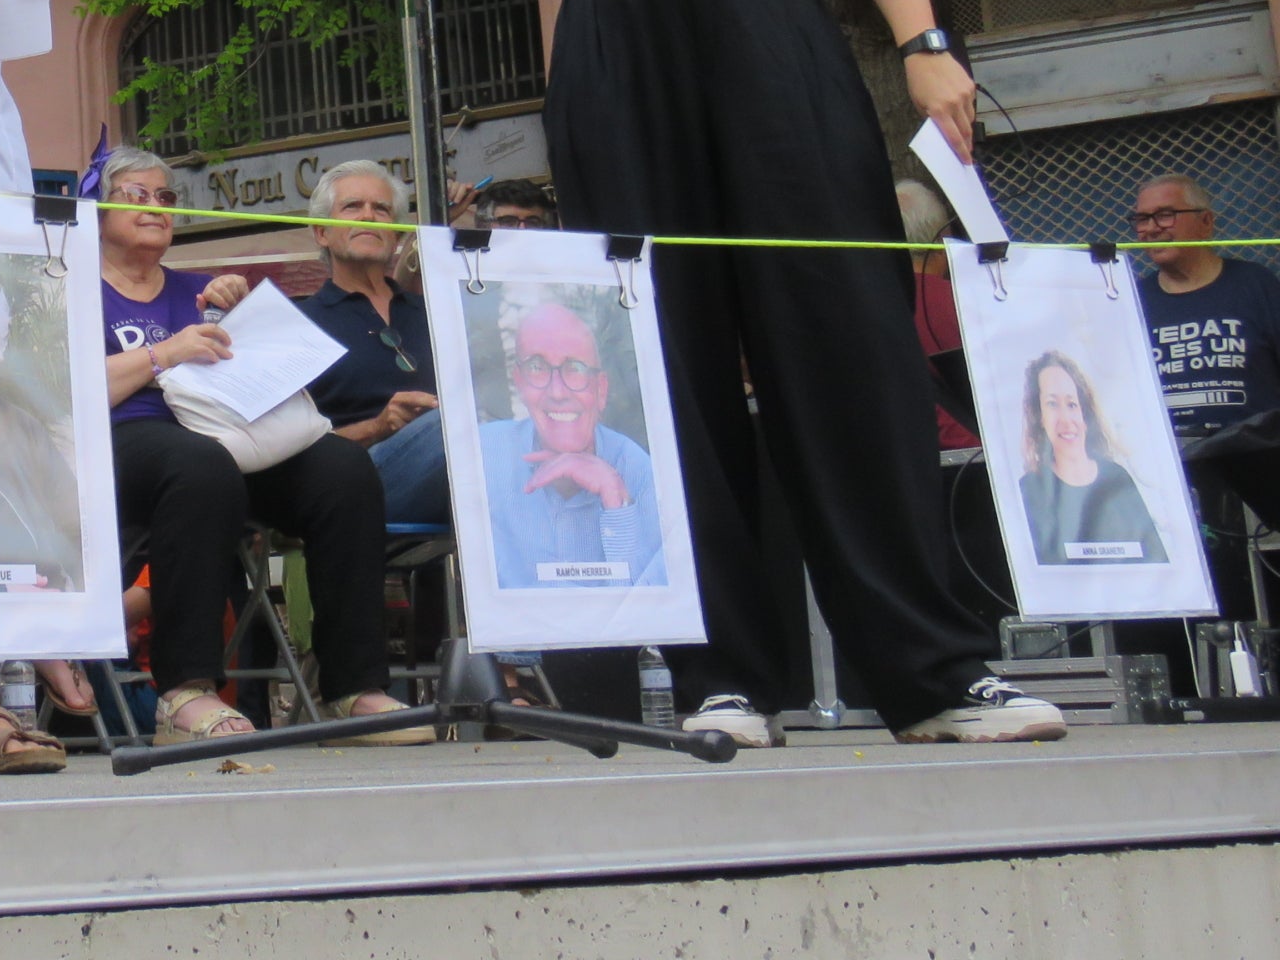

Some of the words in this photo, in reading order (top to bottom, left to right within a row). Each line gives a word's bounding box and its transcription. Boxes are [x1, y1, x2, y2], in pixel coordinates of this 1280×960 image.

[208, 168, 285, 210] Nou
[1210, 338, 1246, 353] UN
[1158, 360, 1184, 376] ME
[1190, 354, 1246, 370] OVER
